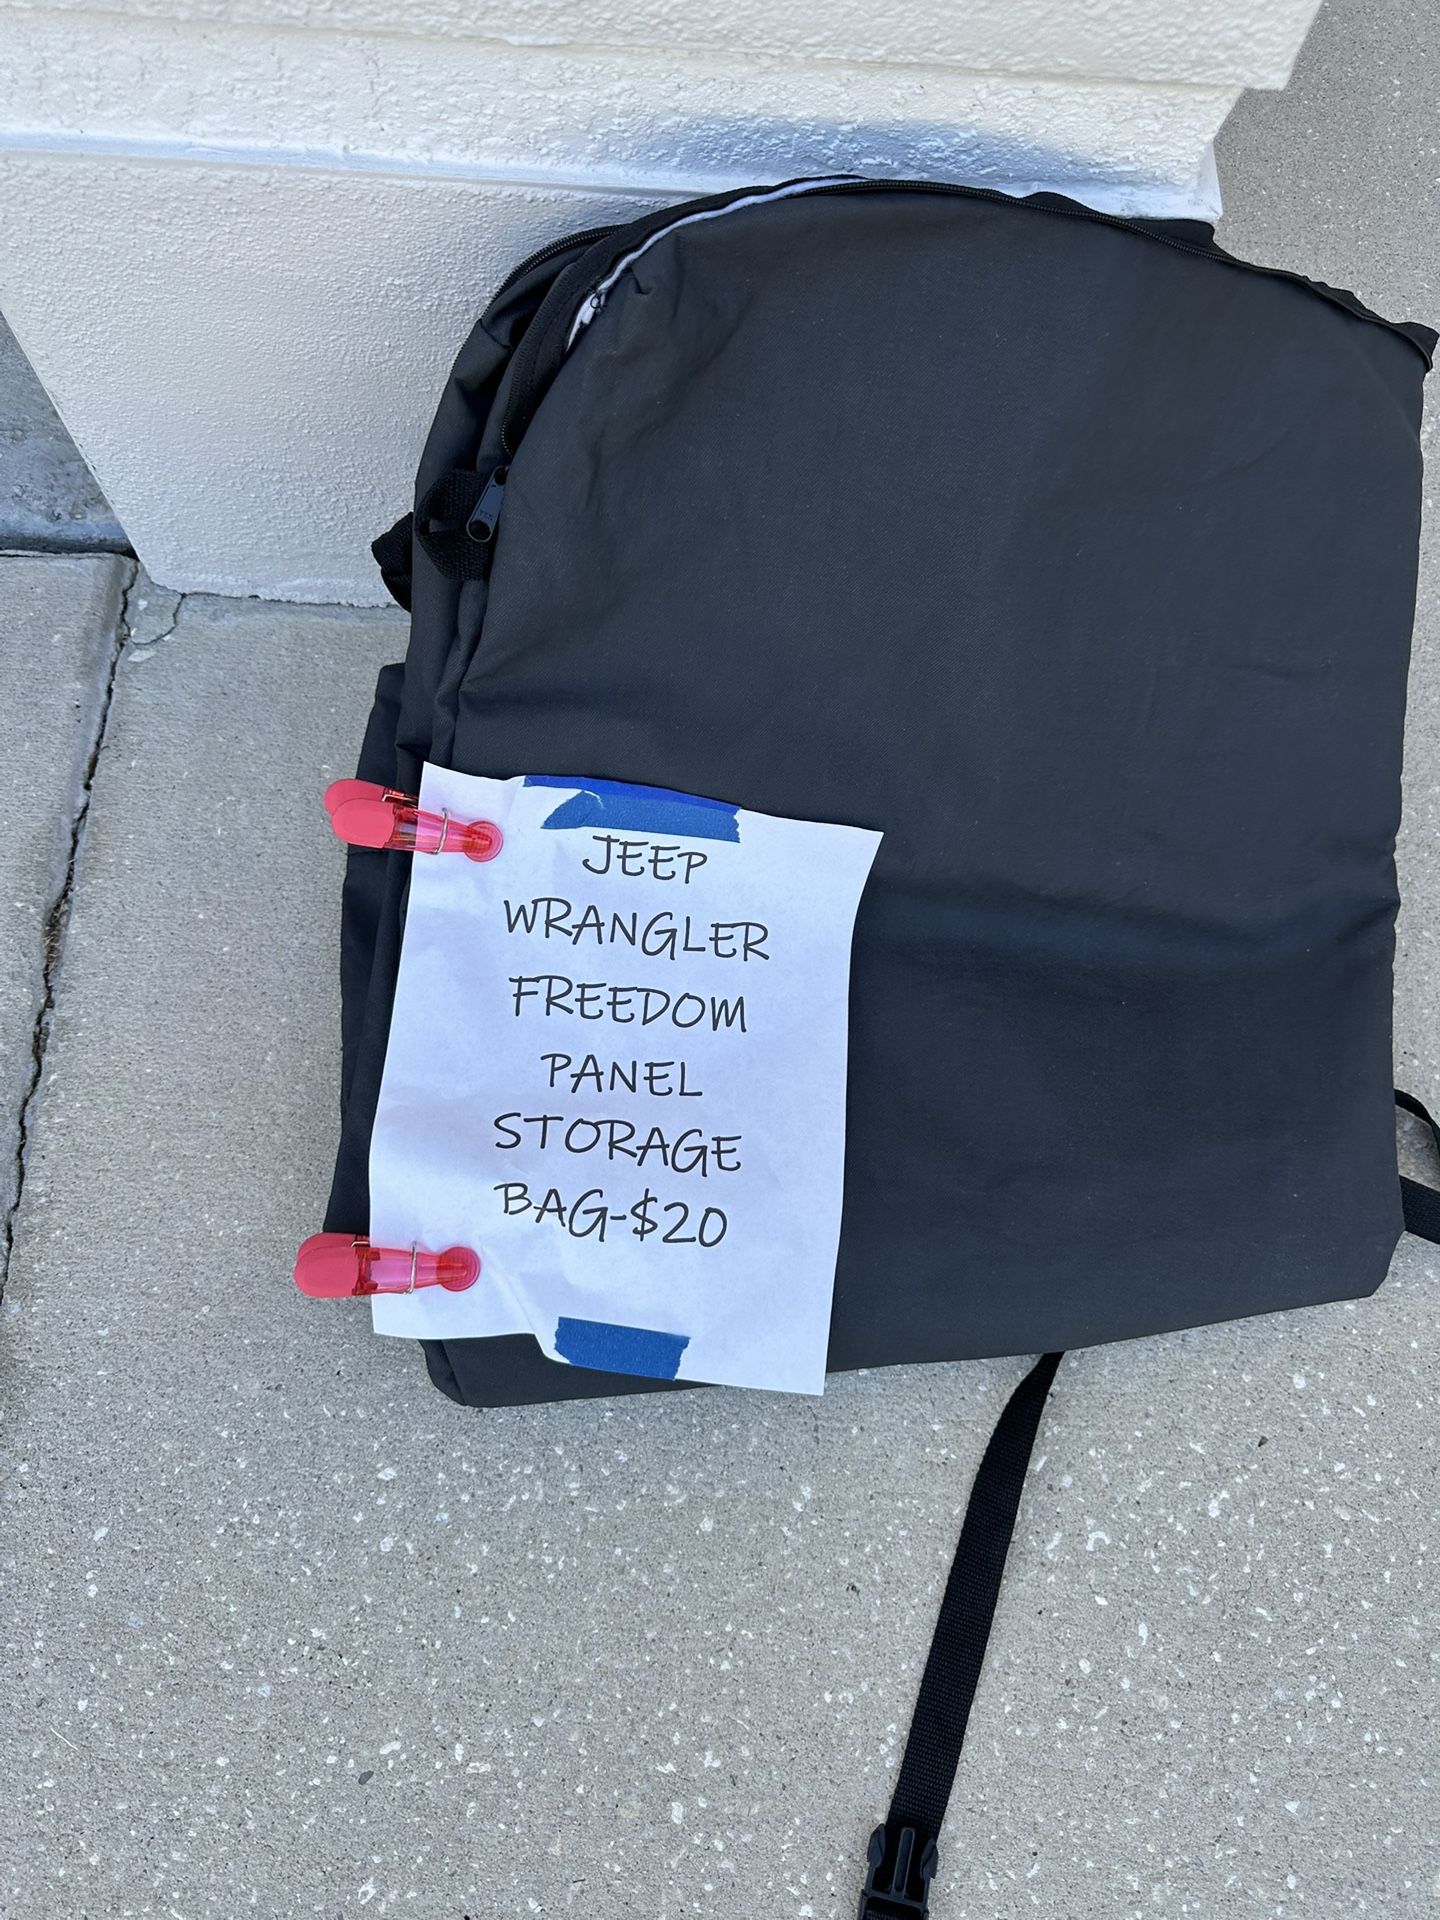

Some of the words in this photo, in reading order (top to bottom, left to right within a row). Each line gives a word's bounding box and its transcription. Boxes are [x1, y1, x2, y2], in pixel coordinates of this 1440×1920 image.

[582, 834, 709, 885] JEEP
[503, 897, 770, 962] WRANGLER
[508, 974, 747, 1033] FREEDOM
[540, 1053, 703, 1097] PANEL
[493, 1112, 742, 1178] STORAGE
[493, 1182, 728, 1248] BAG-$20
